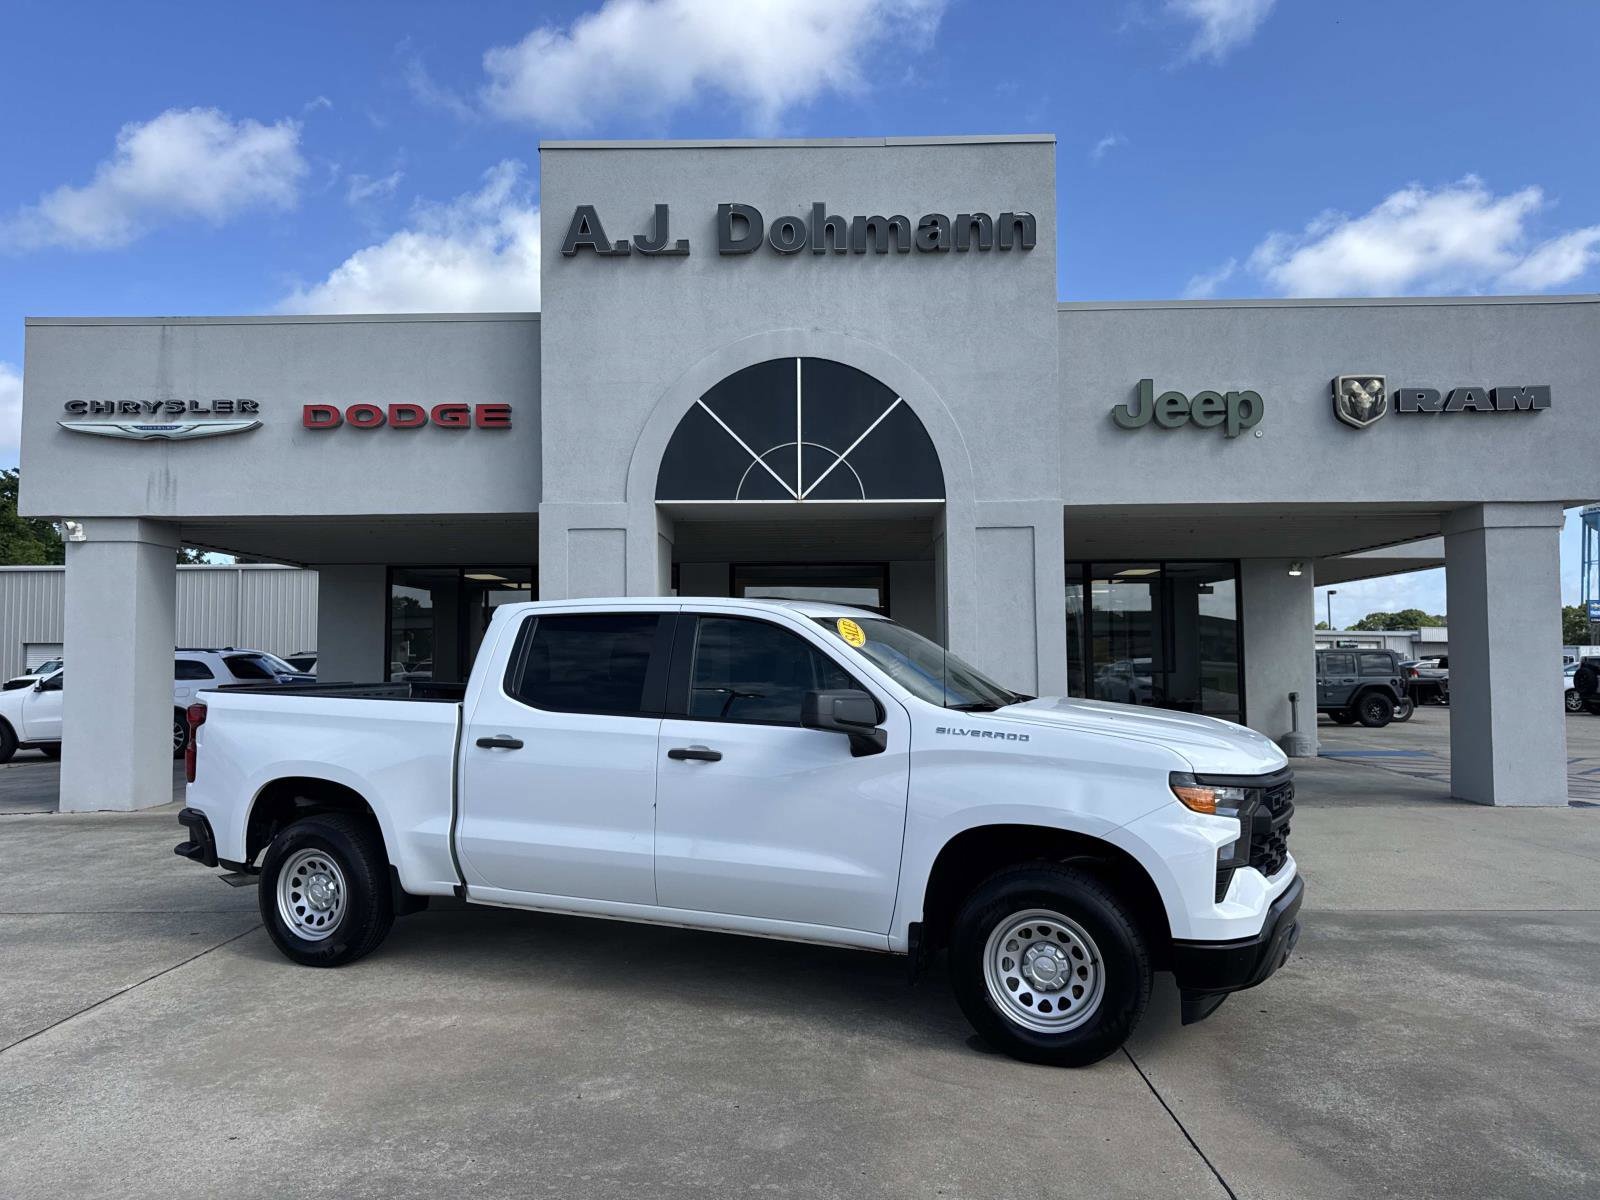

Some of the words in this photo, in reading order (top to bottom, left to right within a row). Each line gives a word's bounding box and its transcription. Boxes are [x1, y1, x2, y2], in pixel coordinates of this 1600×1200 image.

[560, 203, 690, 257] A.J.
[717, 202, 1037, 256] Dohmann
[64, 399, 260, 414] CHRYSLER
[1113, 379, 1264, 438] Jeep
[1396, 385, 1551, 414] RAM
[303, 403, 512, 429] DODGE
[842, 620, 861, 643] SALE
[935, 727, 1030, 742] SILVERADO
